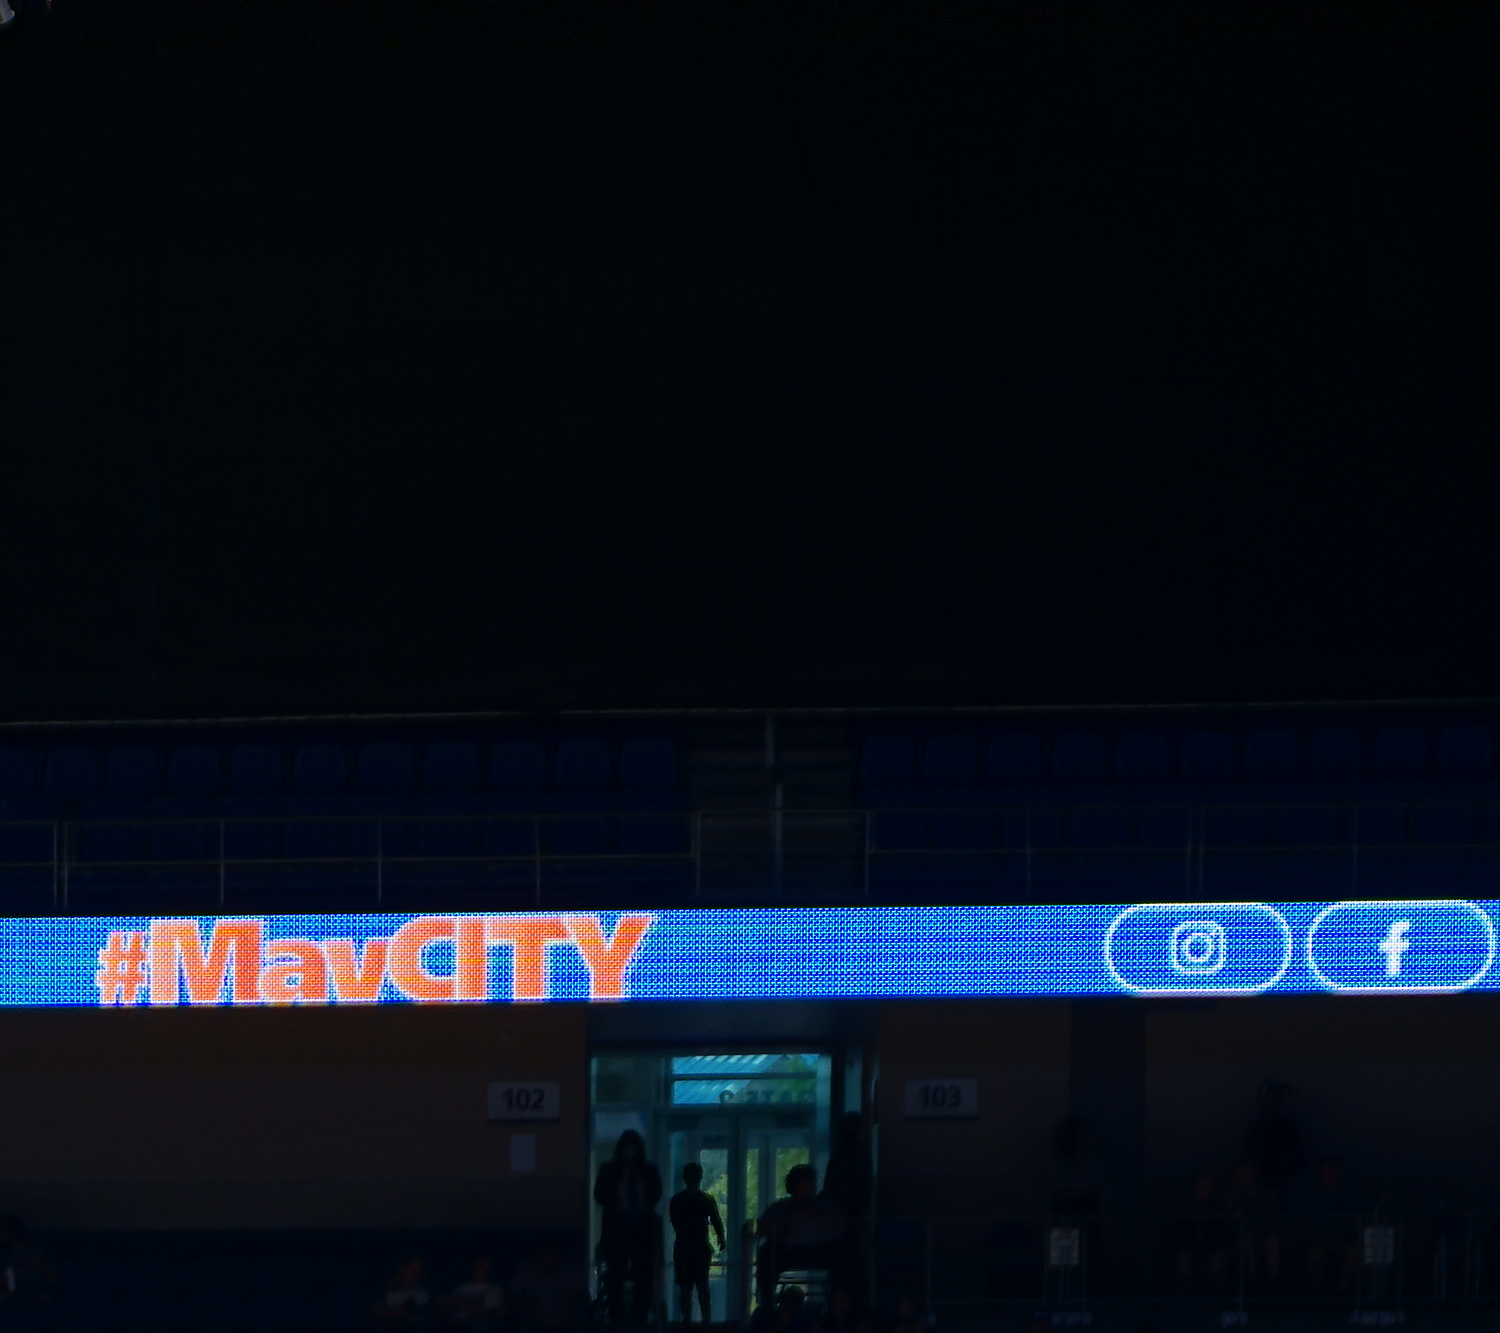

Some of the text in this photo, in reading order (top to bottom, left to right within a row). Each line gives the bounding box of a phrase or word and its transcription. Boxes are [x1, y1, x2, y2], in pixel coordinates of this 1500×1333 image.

[96, 914, 656, 1006] #MavCITY
[502, 1088, 545, 1111] 102
[919, 1084, 962, 1108] 103
